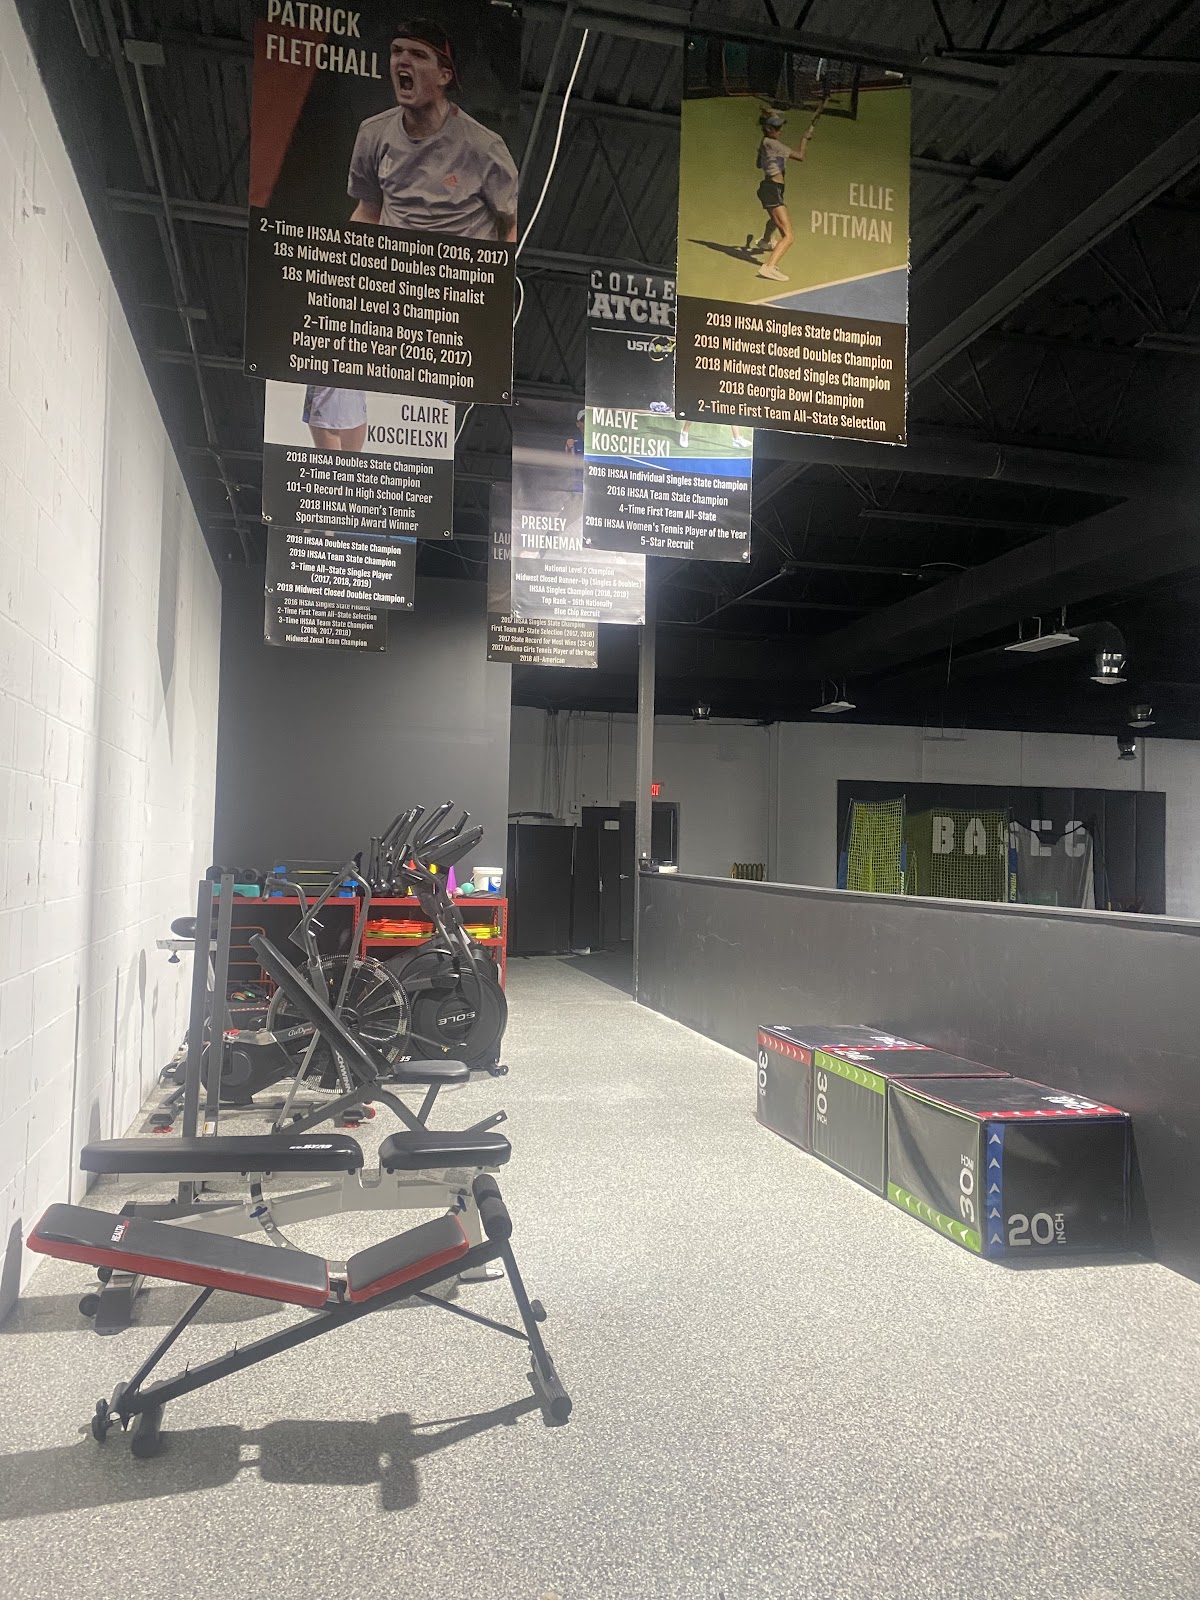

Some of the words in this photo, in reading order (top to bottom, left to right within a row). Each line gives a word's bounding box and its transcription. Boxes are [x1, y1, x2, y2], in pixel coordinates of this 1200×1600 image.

[267, 0, 360, 38] PATRICK
[266, 34, 382, 80] FLETCHALL
[850, 182, 894, 212] ELLIE
[811, 210, 892, 244] PITTMAN
[260, 218, 304, 238] 2-Time
[308, 226, 341, 243] IHSAA
[344, 231, 374, 247] State
[378, 236, 434, 256] Champion
[437, 242, 474, 263] (2016,
[477, 249, 508, 266] 2017)
[274, 242, 294, 257] 18s
[298, 245, 347, 264] Midwest
[350, 253, 387, 270] Closed
[391, 258, 436, 276] Doubles
[439, 265, 494, 284] Champion
[308, 292, 357, 310] National
[360, 298, 389, 314] Level
[393, 303, 400, 316] 3
[403, 304, 459, 323] Champion
[587, 291, 671, 326] ATCH
[304, 315, 346, 332] 2-Time
[350, 320, 393, 338] Indiana
[397, 326, 423, 343] Boys
[426, 329, 463, 346] Tennis
[706, 313, 731, 327] 2019
[735, 316, 763, 331] IHSAA
[766, 320, 802, 337] Singles
[805, 325, 831, 340] State
[833, 328, 881, 347] Champion
[293, 332, 330, 350] Player
[334, 336, 346, 350] of
[348, 338, 367, 353] the
[370, 340, 397, 357] Year
[400, 343, 436, 363] (2016,
[440, 349, 472, 367] 2017)
[627, 340, 656, 352] USTA
[694, 334, 719, 349] 2019
[723, 338, 765, 354] Midwest
[768, 343, 800, 358] Closed
[803, 347, 842, 364] Doubles
[844, 352, 892, 370] Champion
[290, 354, 328, 374] Spring
[332, 359, 363, 375] Team
[367, 363, 414, 381] National
[418, 369, 474, 388] Champion
[695, 356, 720, 371] 2018
[724, 360, 766, 376] Midwest
[769, 365, 801, 380] Closed
[804, 368, 839, 386] Singles
[842, 373, 890, 391] Champion
[719, 380, 744, 395] 2018
[747, 384, 786, 401] Georgia
[789, 388, 812, 402] Bowl
[815, 391, 864, 409] Champion
[401, 404, 449, 425] CLAIRE
[592, 407, 638, 430] MAEVE
[698, 400, 736, 415] 2-Time
[739, 403, 762, 418] First
[764, 406, 791, 420] Team
[794, 410, 838, 425] All-State
[841, 415, 886, 431] Selection
[367, 425, 448, 449] KOSCIELSKI
[592, 432, 670, 457] KOSCIELSKI
[286, 451, 307, 462] 2018
[309, 454, 333, 465] IHSAA
[335, 456, 368, 468] Doubles
[370, 459, 391, 470] State
[394, 461, 433, 475] Champion
[300, 468, 330, 480] 2-Time
[332, 471, 354, 482] Team
[356, 473, 378, 484] State
[380, 475, 420, 488] Champion
[588, 466, 606, 477] 2016
[608, 469, 628, 479] IHSAA
[630, 471, 665, 483] Individual
[666, 474, 692, 487] Singles
[693, 477, 712, 488] State
[713, 479, 748, 491] Champion
[287, 481, 312, 493] 101-0
[314, 484, 343, 495] Record
[345, 486, 353, 496] In
[356, 487, 374, 500] High
[376, 489, 403, 501] School
[406, 492, 433, 503] Career
[607, 485, 625, 496] 2016
[627, 488, 648, 499] IHSAA
[650, 490, 670, 500] Team
[671, 492, 690, 502] State
[692, 494, 728, 507] Champion
[300, 499, 320, 510] 2018
[323, 501, 347, 512] IHSAA
[389, 506, 415, 518] Tennis
[619, 504, 645, 515] 4-Time
[647, 506, 663, 516] First
[665, 508, 683, 518] Team
[685, 510, 716, 521] All-State
[296, 512, 359, 528] Sportsmanship
[361, 517, 387, 528] Award
[389, 519, 419, 531] Winner
[521, 516, 566, 532] PRESLEY
[585, 516, 602, 527] 2016
[604, 518, 625, 529] IHSAA
[660, 524, 683, 534] Tennis
[685, 526, 707, 538] Player
[708, 528, 716, 537] of
[717, 528, 729, 538] the
[731, 530, 747, 539] Year
[640, 536, 666, 547] 5-Star
[667, 538, 694, 550] Recruit
[289, 548, 306, 557] 2019
[307, 550, 326, 559] IHSAA
[327, 552, 344, 561] Team
[346, 554, 363, 563] State
[364, 556, 396, 567] Champion
[290, 561, 315, 571] 3-Time
[316, 564, 346, 574] All-State
[346, 567, 370, 578] Singles
[372, 570, 392, 580] Player
[311, 573, 331, 585] (2017,
[333, 576, 351, 587] 2018,
[352, 577, 372, 588] 2019)
[277, 583, 293, 592] 2018
[295, 585, 322, 595] Midwest
[324, 588, 345, 597] Closed
[346, 590, 372, 600] Doubles
[373, 593, 405, 603] Champion
[438, 1011, 476, 1026] SOLE
[758, 1050, 768, 1088] 30
[816, 1072, 828, 1114] 30
[960, 1167, 975, 1223] 30
[1008, 1212, 1054, 1246] 20
[1054, 1213, 1066, 1244] INCH
